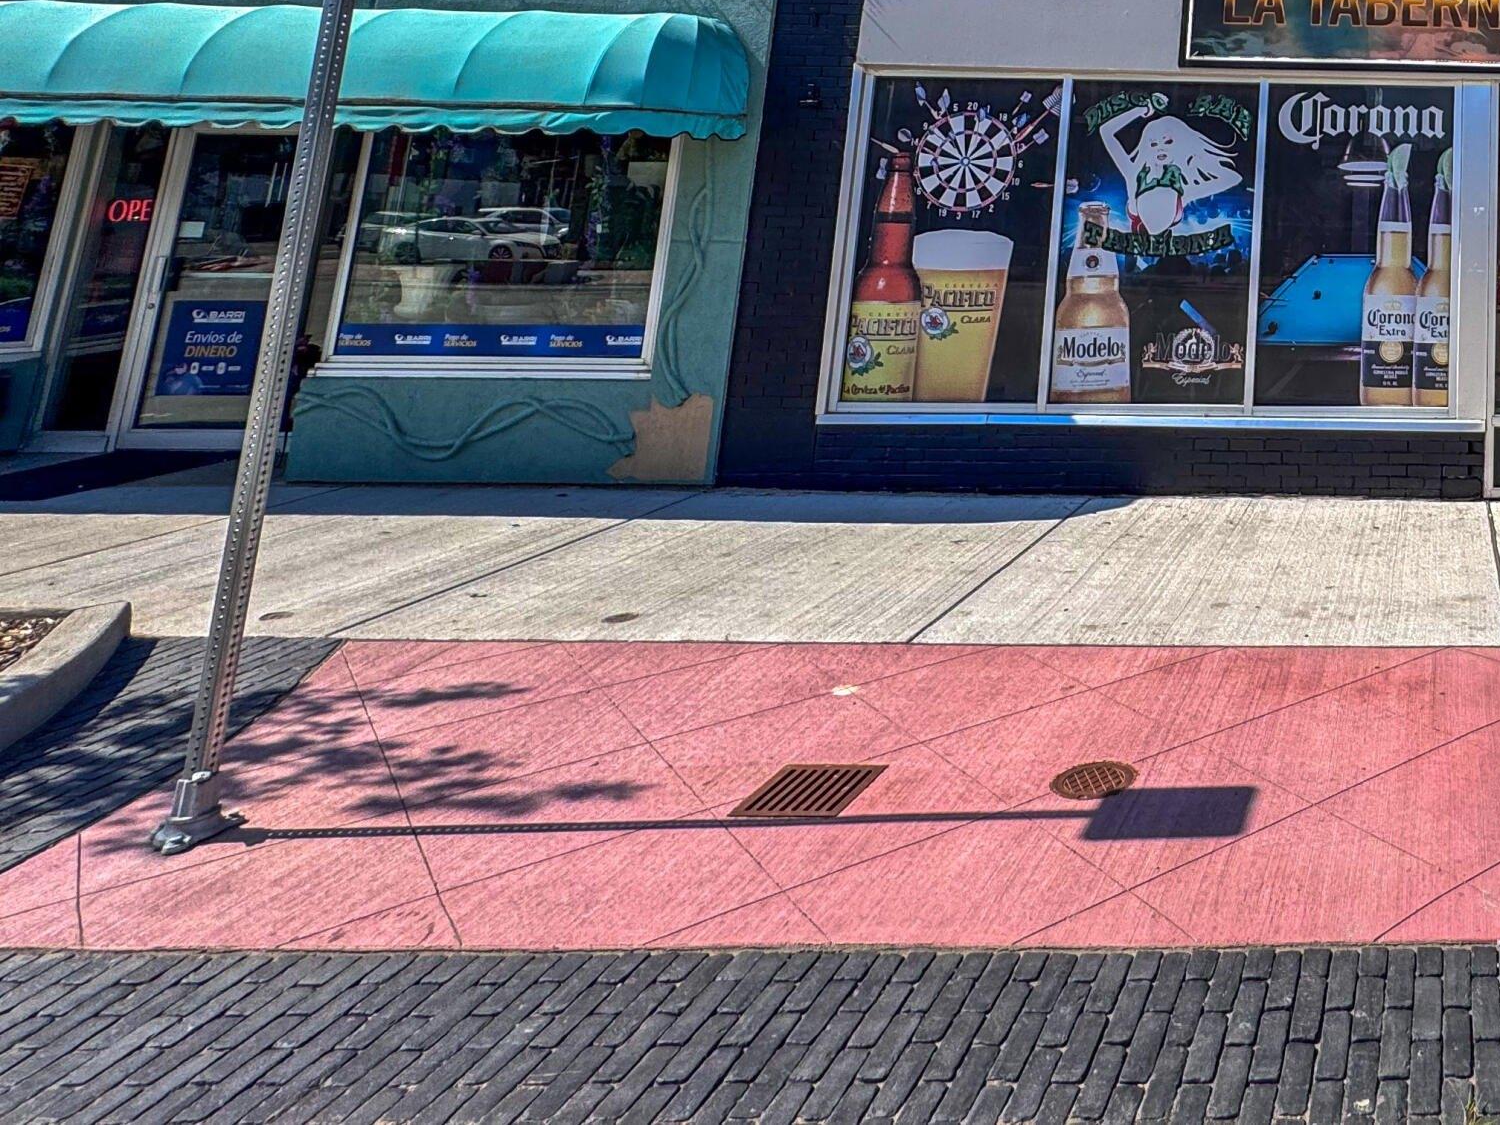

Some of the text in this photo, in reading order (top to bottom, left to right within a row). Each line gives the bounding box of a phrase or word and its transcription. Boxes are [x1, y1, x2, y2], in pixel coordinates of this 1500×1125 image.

[953, 103, 959, 112] 5
[967, 102, 978, 111] 20
[1084, 91, 1252, 141] DISCO BAR
[1278, 91, 1446, 150] Corona
[1018, 160, 1024, 168] 6
[1135, 163, 1184, 198] LA
[1001, 192, 1010, 200] 15
[108, 199, 152, 222] OPE
[938, 209, 947, 217] 19
[971, 210, 980, 218] 17
[988, 204, 995, 212] 2
[1083, 220, 1236, 257] TABERNA
[921, 283, 996, 308] PACIFICO
[208, 311, 246, 319] BARRI
[960, 315, 991, 324] CLARA
[1376, 324, 1406, 336] Extra
[184, 331, 243, 344] Envíos de
[184, 345, 238, 357] DINERO
[1063, 337, 1120, 358] Modelo
[1155, 332, 1231, 361] Modelo
